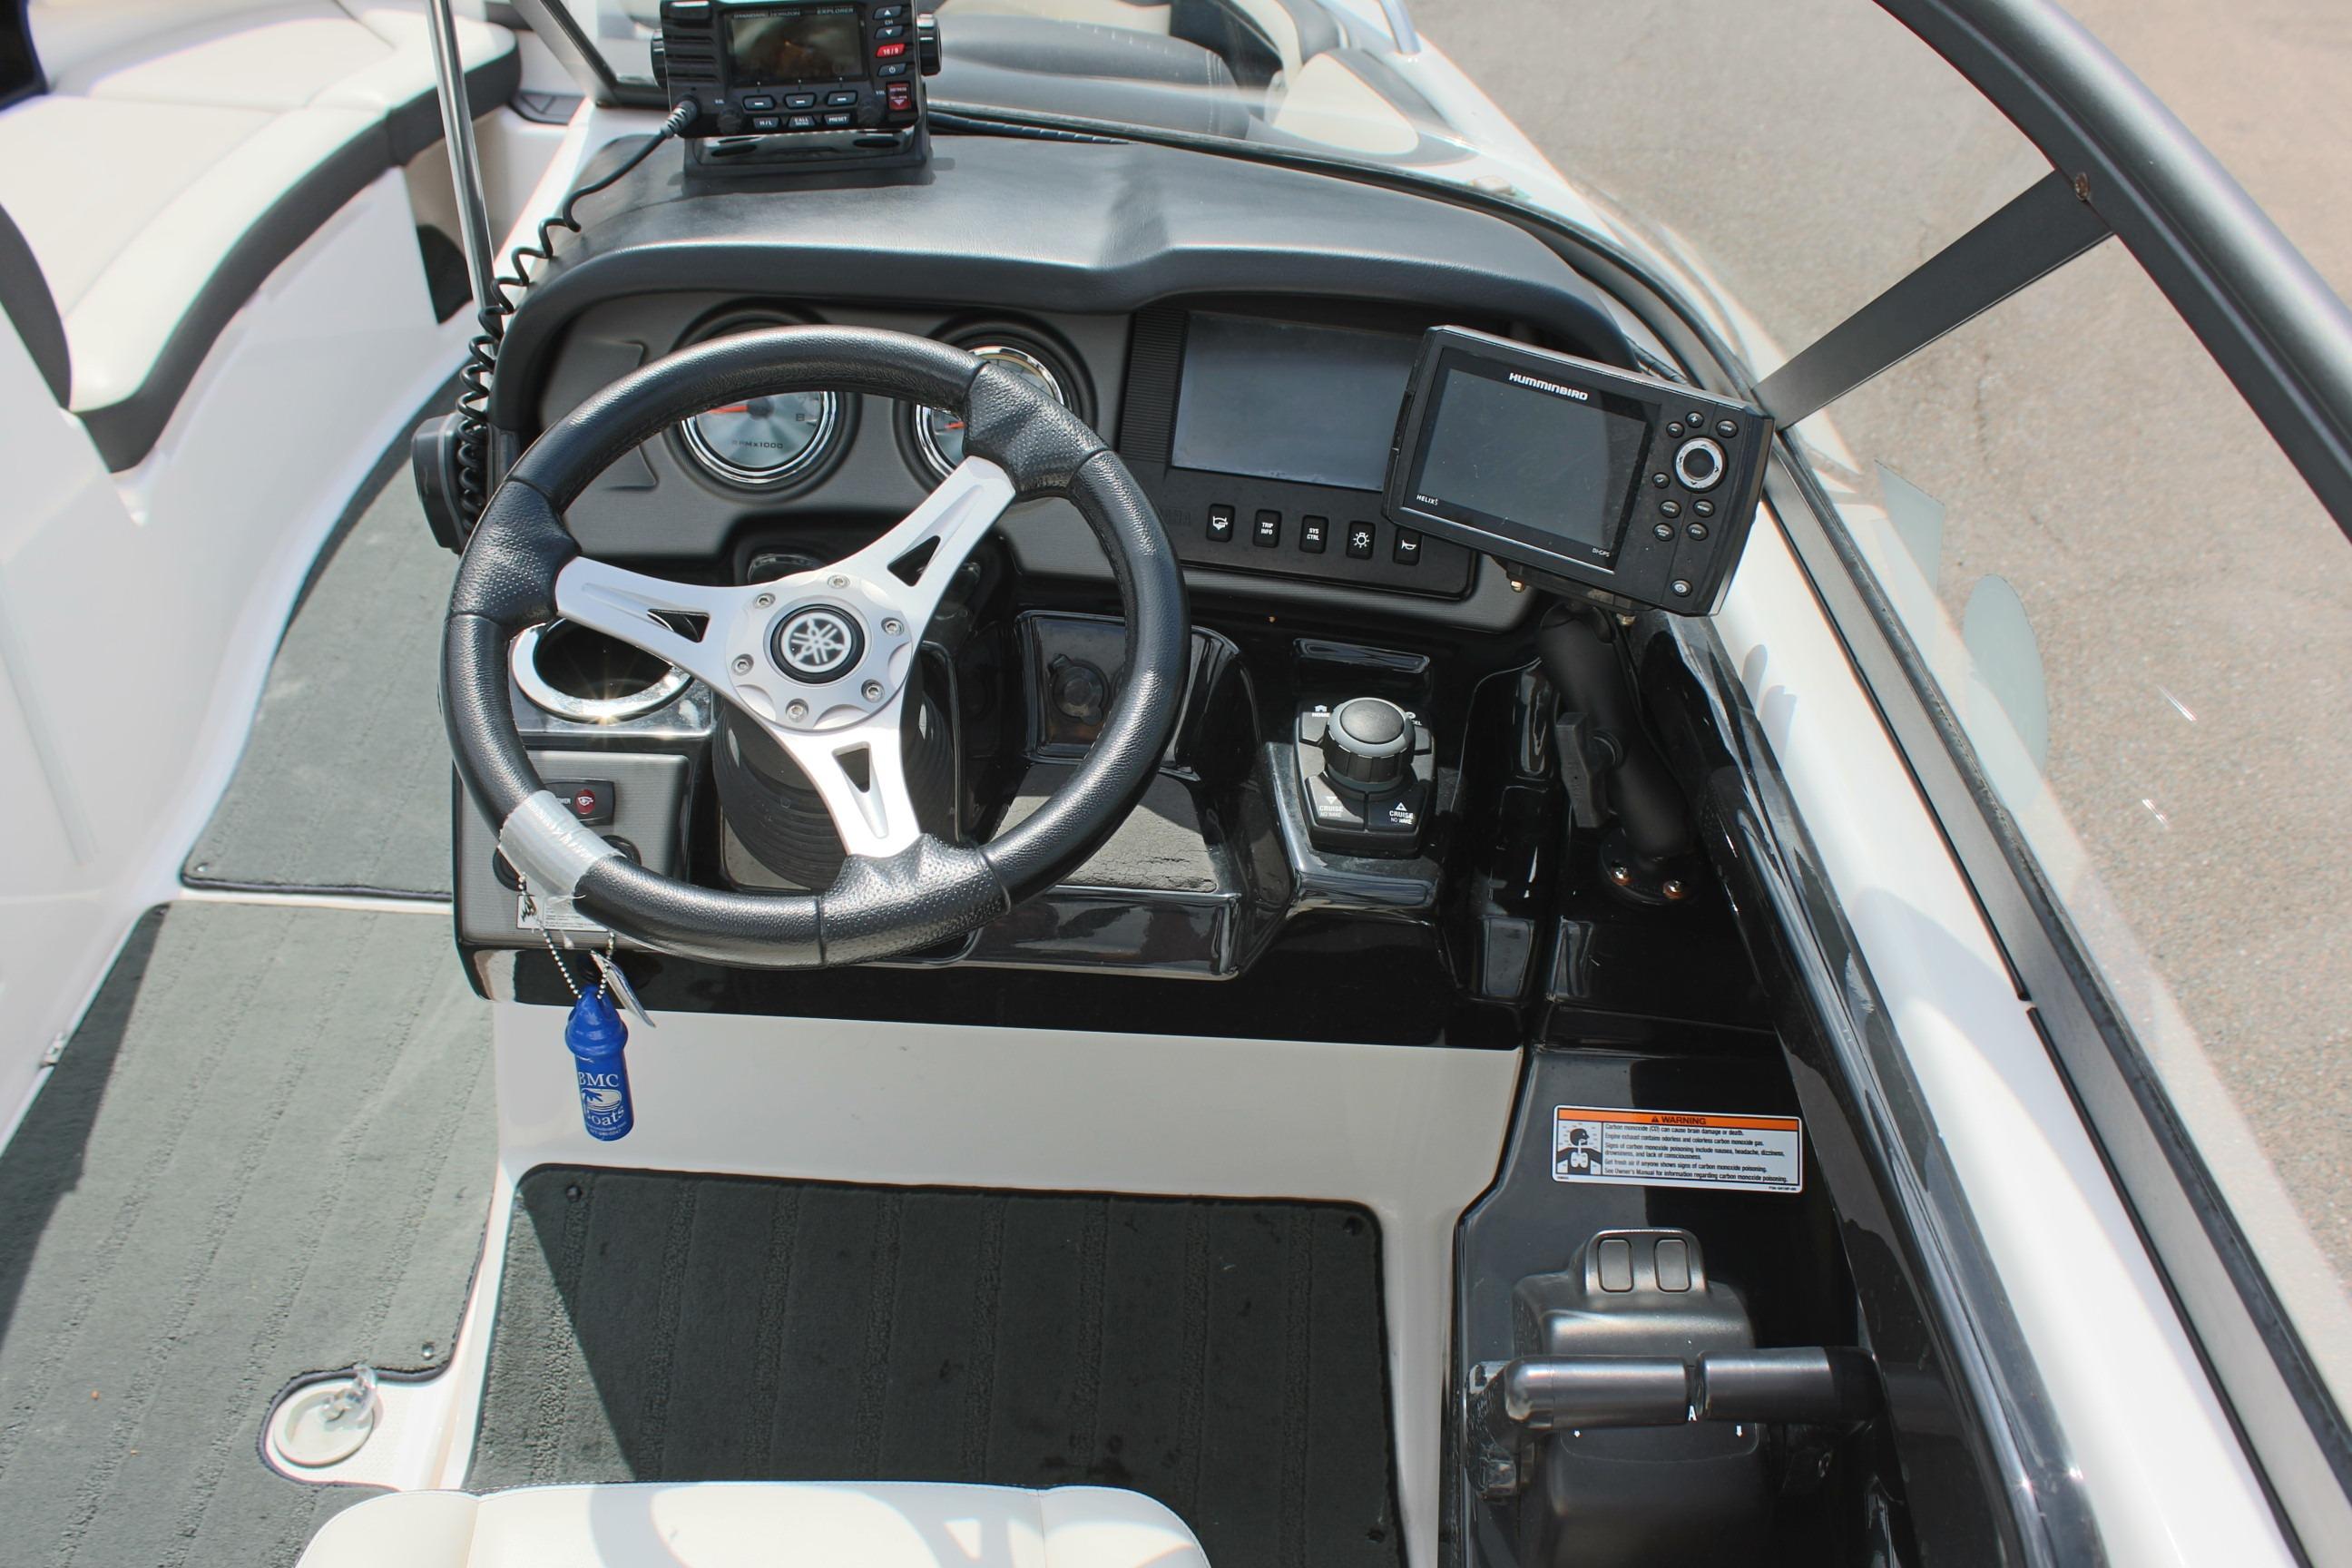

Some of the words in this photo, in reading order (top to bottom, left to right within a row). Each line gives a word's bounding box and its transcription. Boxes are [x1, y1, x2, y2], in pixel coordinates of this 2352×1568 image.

[1508, 372, 1589, 402] HUMMINBIRD
[1416, 494, 1435, 505] HELIX
[1307, 534, 1319, 542] CTRL
[1389, 810, 1415, 818] CRUISE
[578, 1072, 620, 1087] BMC
[1662, 1116, 1707, 1124] WARNING
[1688, 1405, 1697, 1422] A
